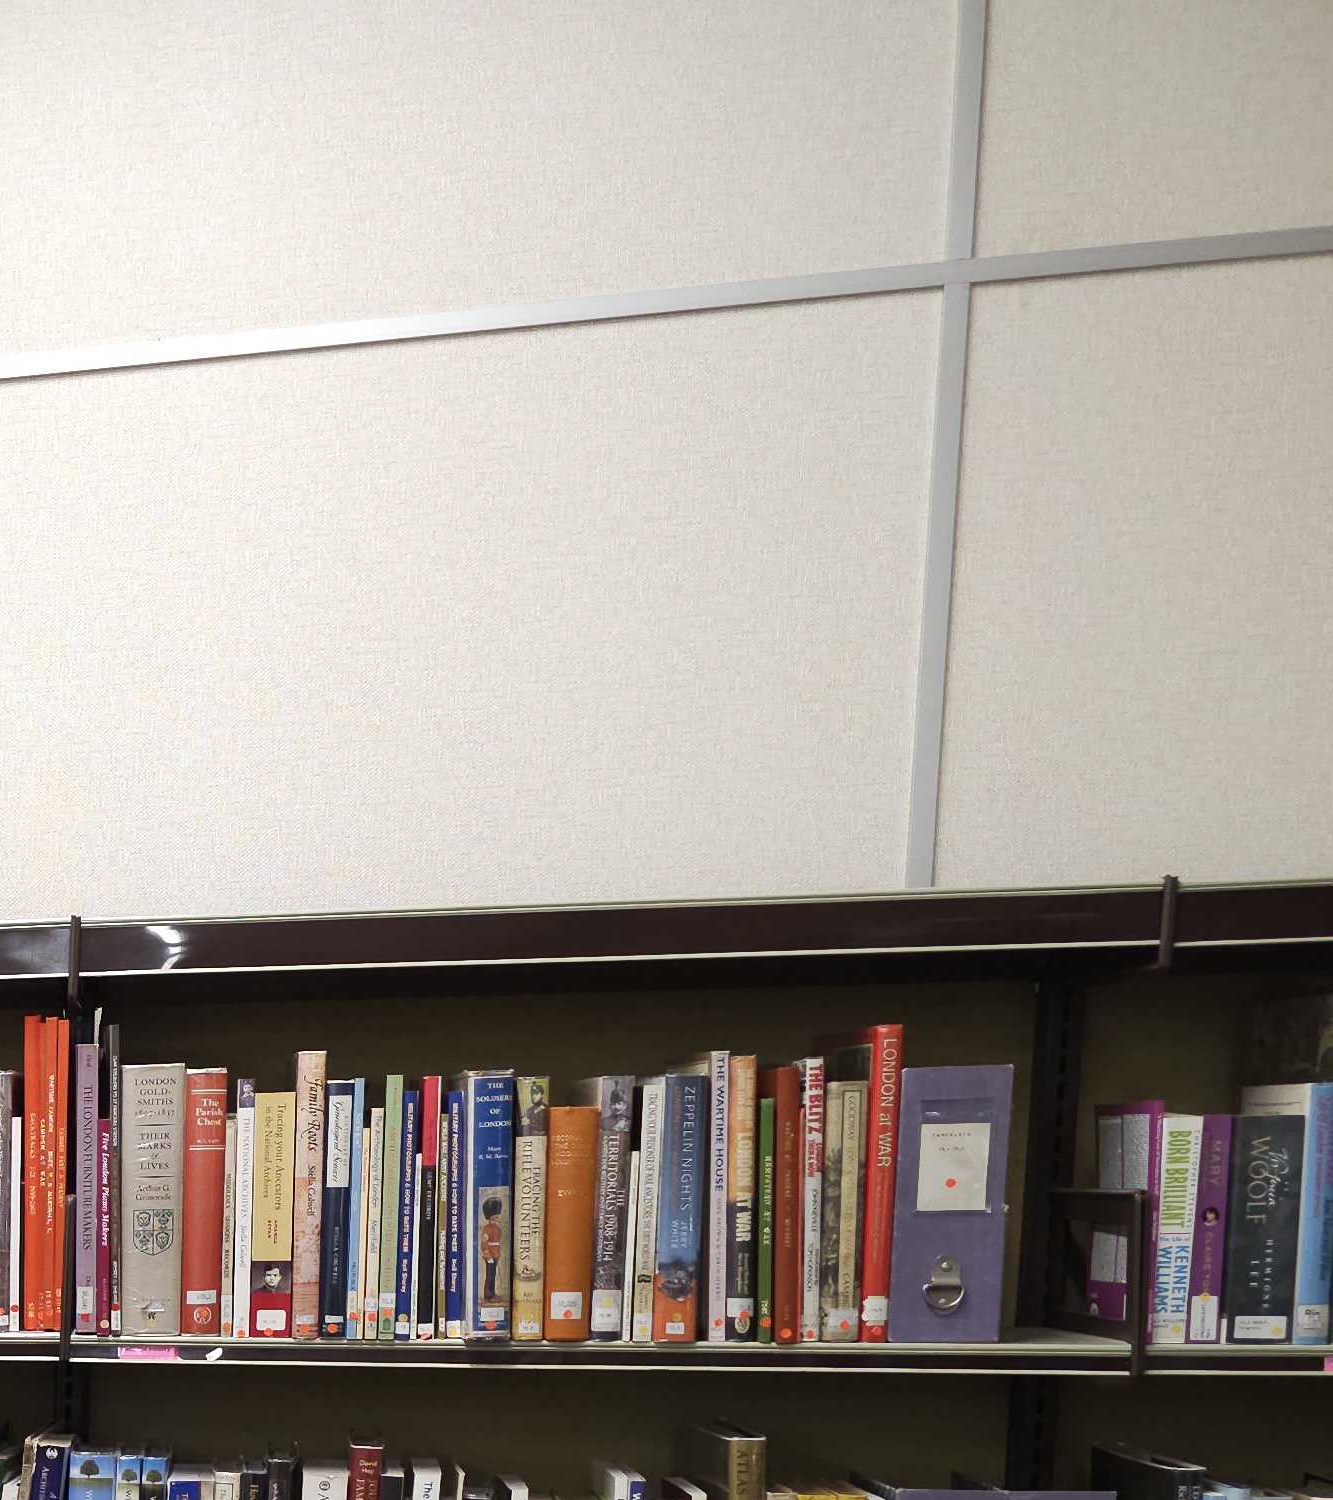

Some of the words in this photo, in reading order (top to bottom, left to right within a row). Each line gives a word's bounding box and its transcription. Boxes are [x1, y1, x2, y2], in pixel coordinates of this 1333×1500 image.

[134, 1077, 177, 1086] LONDON
[716, 1056, 725, 1082] THE
[808, 1064, 823, 1090] THE
[881, 1039, 897, 1107] LONDON
[83, 1086, 92, 1105] THE
[138, 1097, 173, 1105] SMITHS
[139, 1087, 171, 1096] GOLD-
[202, 1099, 219, 1107] The
[196, 1107, 223, 1117] Parish
[197, 1117, 222, 1126] Chest
[276, 1103, 287, 1139] Tracing
[682, 1086, 696, 1152] ZEPPELIN
[714, 1086, 725, 1144] WARTIME
[808, 1092, 822, 1140] BLITZ
[879, 1113, 890, 1126] at
[83, 1106, 92, 1157] LONDON
[139, 1132, 170, 1140] THEIR
[877, 1132, 892, 1167] WAR
[1167, 1131, 1192, 1164] BORN
[140, 1162, 169, 1170] LIVES
[522, 1141, 532, 1170] RIFLE
[606, 1135, 619, 1211] TERRITORIALS
[714, 1150, 724, 1191] HOUSE
[737, 1133, 751, 1187] LONDON
[83, 1157, 92, 1211] FURNITURE
[680, 1158, 693, 1211] NIGHTS
[1161, 1167, 1188, 1228] BRILLIANT
[1245, 1136, 1272, 1224] WOOLF
[520, 1173, 531, 1261] VOLUNTEERS
[737, 1192, 751, 1208] AT
[83, 1212, 91, 1250] MAKERS
[603, 1214, 614, 1261] 1908-1914
[735, 1210, 751, 1242] WAR
[1155, 1246, 1172, 1313] WILLIAMS
[1170, 1245, 1190, 1313] KENNETH
